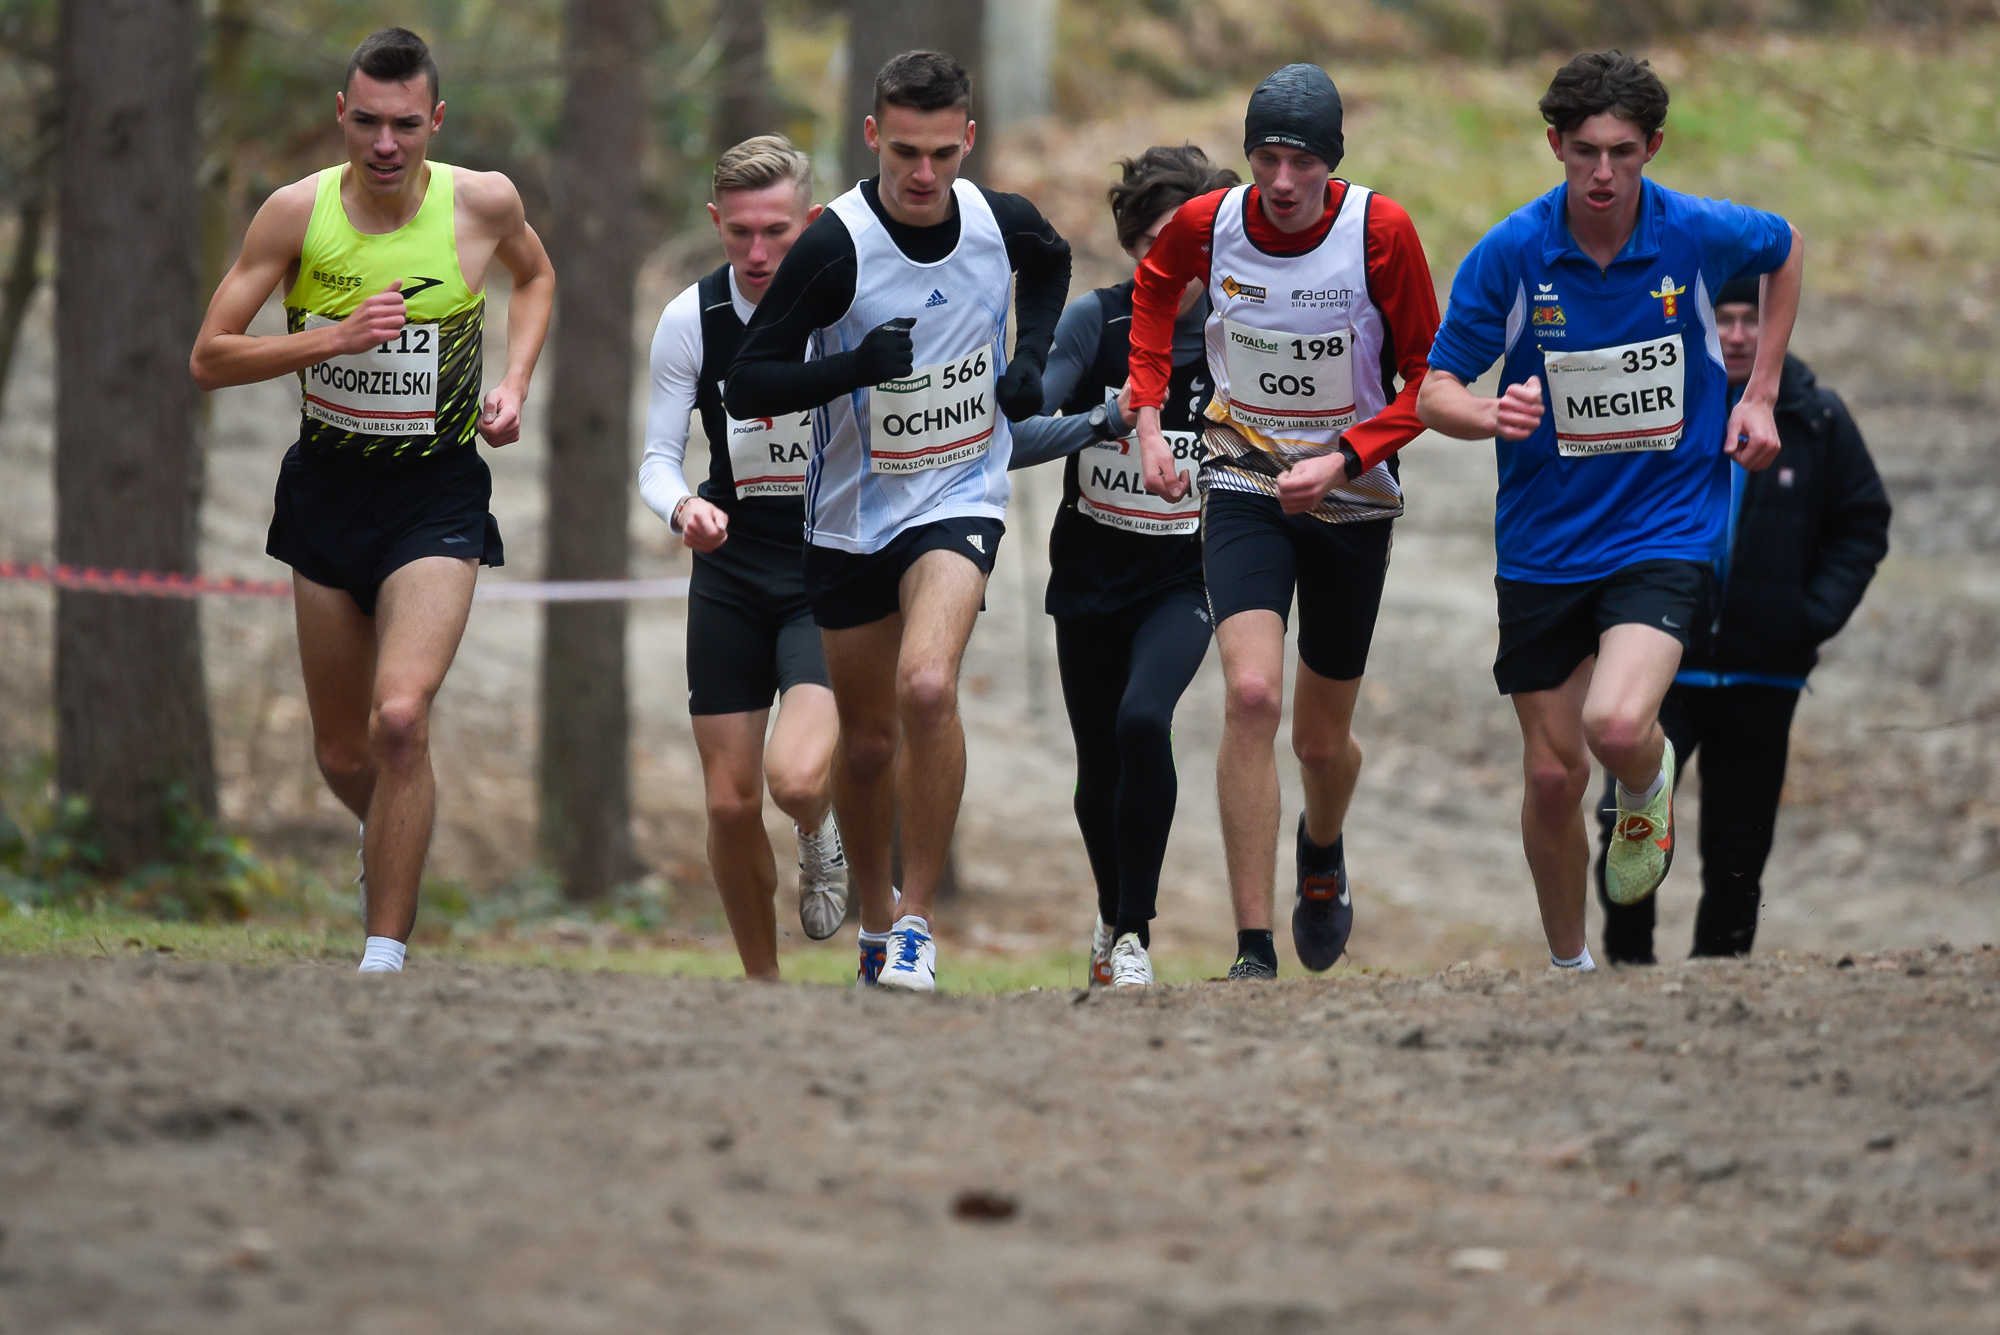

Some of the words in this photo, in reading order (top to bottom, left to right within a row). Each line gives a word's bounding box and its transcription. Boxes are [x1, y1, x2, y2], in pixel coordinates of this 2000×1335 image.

[313, 270, 362, 287] BEASTS
[1240, 286, 1264, 297] OPTIMA
[925, 299, 948, 308] adidas
[1534, 328, 1566, 338] GDAŃSK
[1290, 336, 1344, 361] 198
[1621, 342, 1677, 373] 353
[311, 362, 431, 396] POGORZELSKI
[942, 352, 986, 389] 566
[1259, 372, 1315, 397] GOS
[1566, 385, 1676, 419] MEGIER
[312, 406, 360, 429] TOMASZÓW
[363, 422, 404, 432] LUBELSKI
[407, 422, 429, 431] 2021
[882, 392, 986, 437] OCHNIK
[1234, 410, 1285, 427] TOMASZÓW
[1288, 420, 1328, 428] LUBELSKI
[1332, 416, 1352, 427] 2021
[733, 424, 765, 435] polanik
[768, 440, 809, 463] RA
[1093, 442, 1120, 452] olanik
[1163, 436, 1200, 460] 88
[1565, 441, 1622, 453] TOMASZÓW
[1625, 439, 1666, 449] LUBELSKI
[878, 457, 935, 470] TOMASZÓW
[938, 448, 974, 465] LUBELSKI
[743, 484, 798, 493] TOMASZÓW
[1084, 503, 1132, 527] TOMASZÓW
[1134, 521, 1172, 531] LUBELSKI
[1174, 522, 1194, 530] 2021
